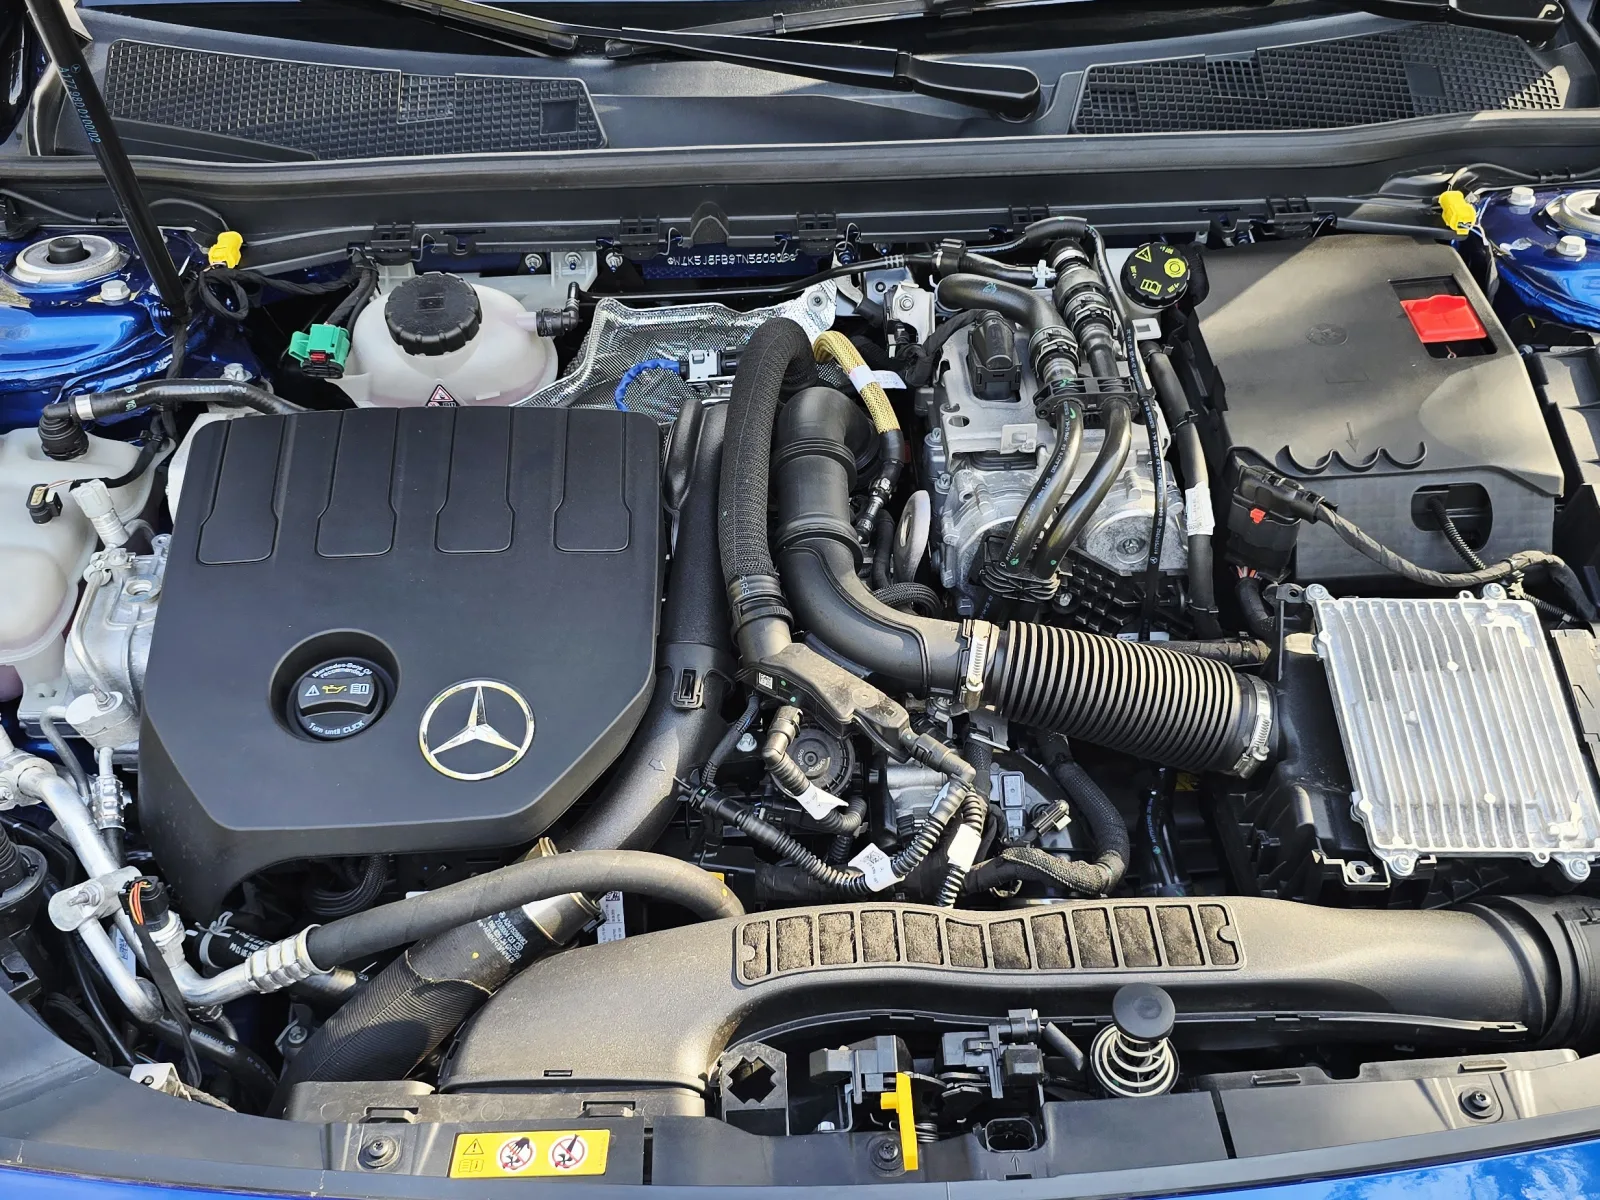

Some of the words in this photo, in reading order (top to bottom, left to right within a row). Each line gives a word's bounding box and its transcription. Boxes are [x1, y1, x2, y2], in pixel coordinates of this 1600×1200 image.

[309, 722, 323, 733] Turn
[324, 727, 340, 735] until
[343, 720, 364, 733] CLICK
